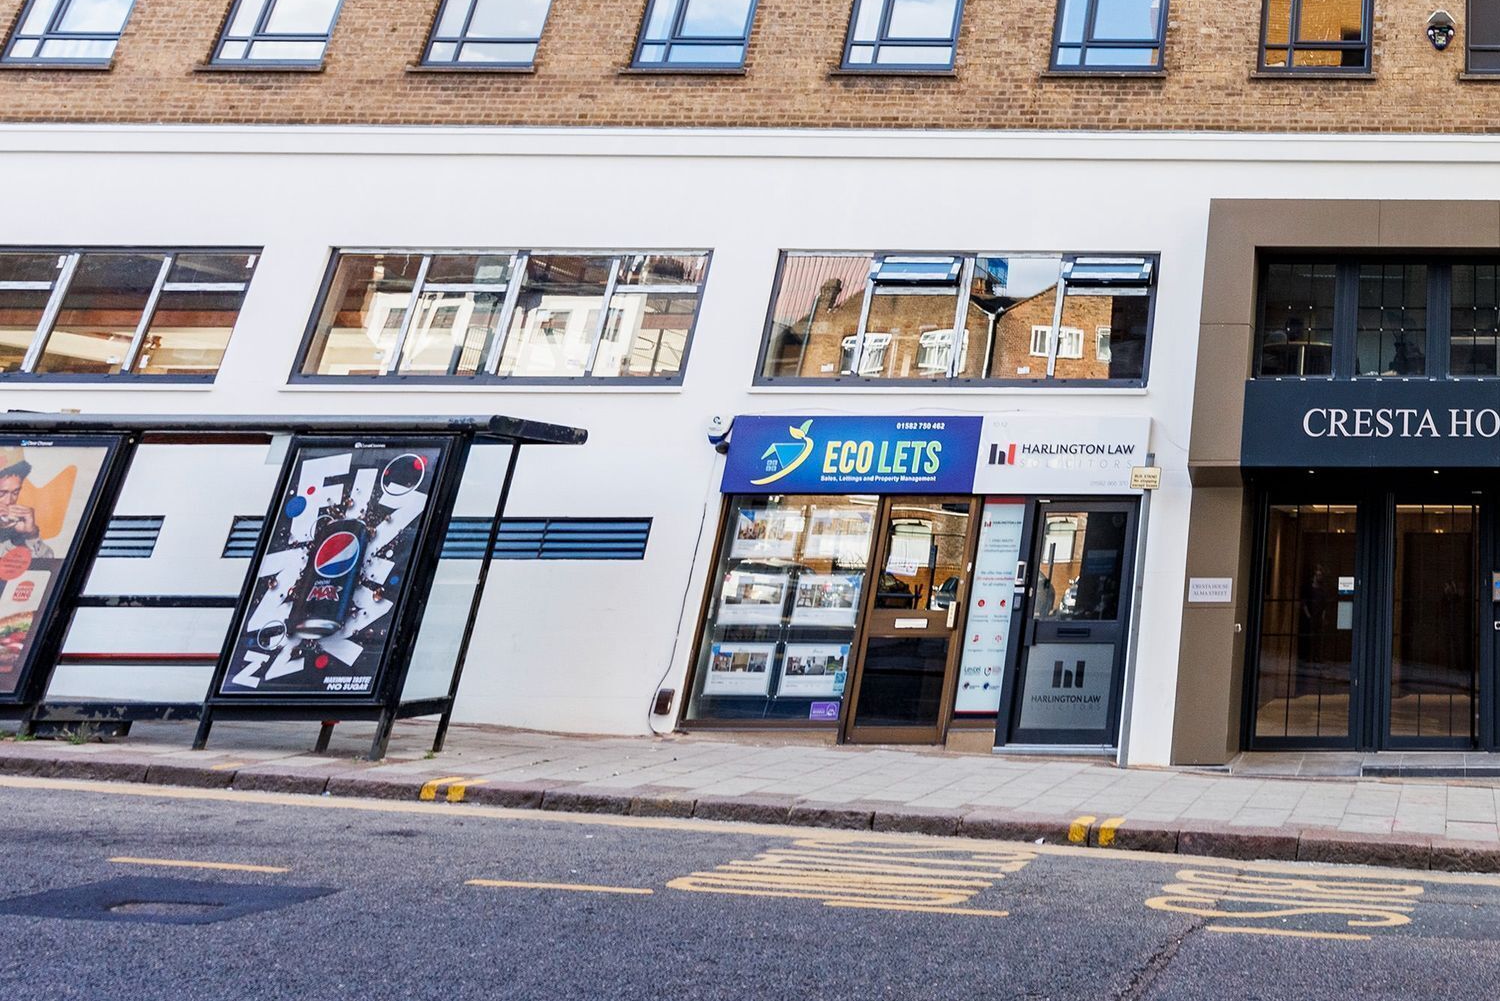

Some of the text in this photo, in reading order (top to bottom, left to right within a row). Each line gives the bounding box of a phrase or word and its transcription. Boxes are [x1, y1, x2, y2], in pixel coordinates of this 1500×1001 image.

[1302, 407, 1441, 439] CRESTA
[1021, 443, 1135, 455] HARLINGTON LAW
[821, 440, 942, 474] ECO LETS
[839, 474, 863, 482] Lettings
[863, 474, 875, 482] and
[875, 474, 900, 482] Property
[900, 474, 937, 483] Management
[306, 585, 340, 602] MAX
[326, 683, 369, 691] NO SUGAR
[1030, 694, 1102, 703] HARLINGTON LAW
[1144, 869, 1425, 927] BUS
